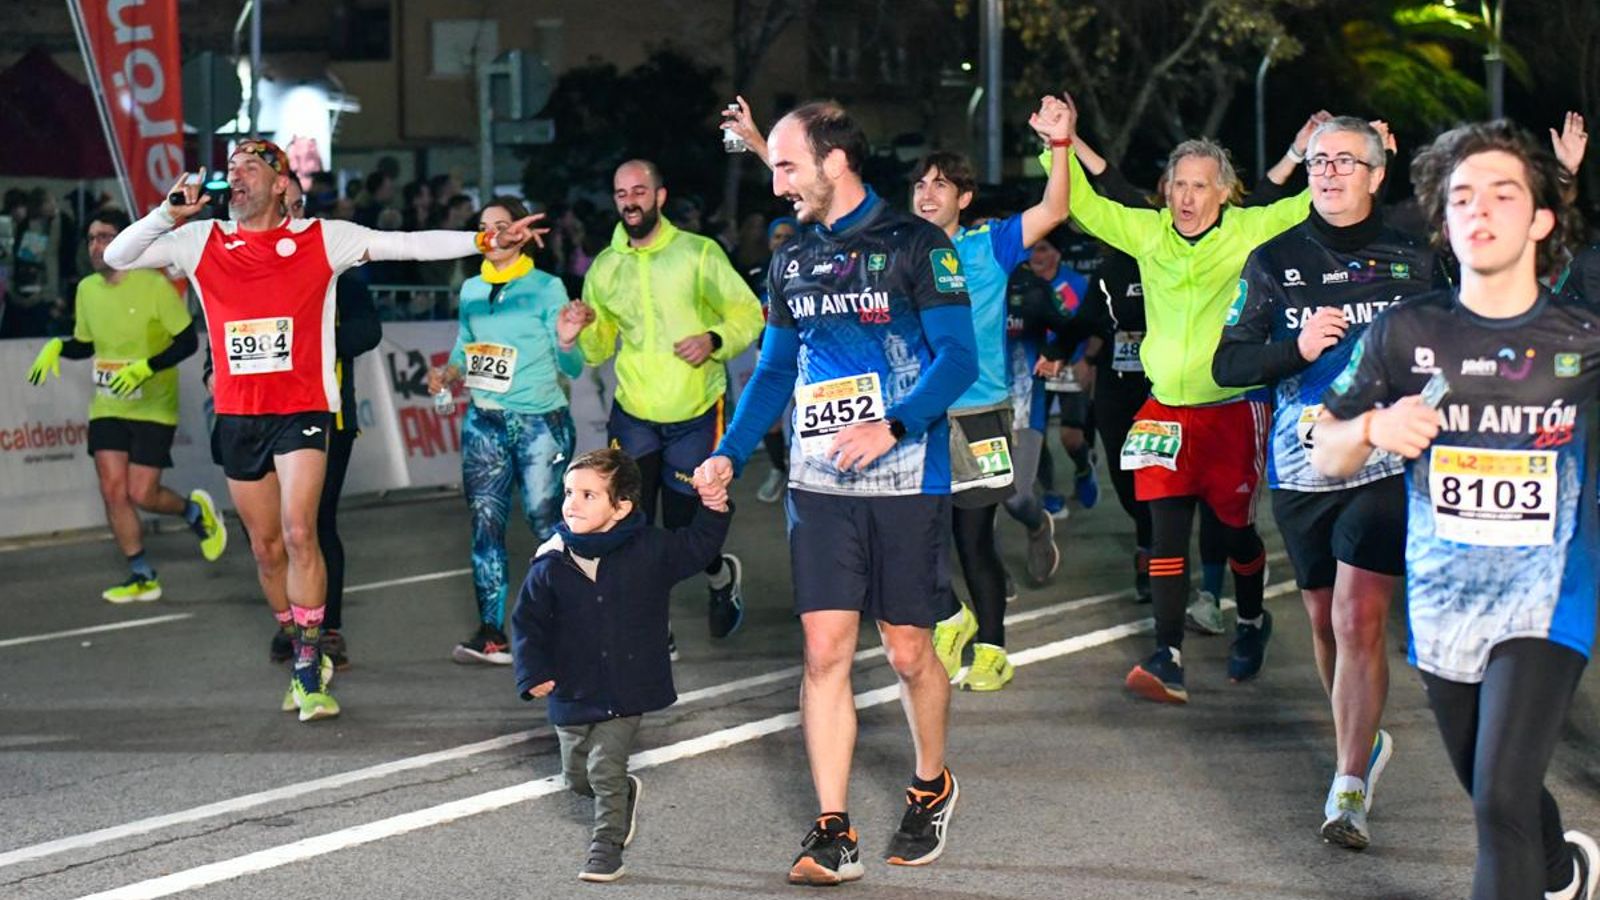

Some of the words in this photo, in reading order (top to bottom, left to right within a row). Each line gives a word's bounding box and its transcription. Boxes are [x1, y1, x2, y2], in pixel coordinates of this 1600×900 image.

[1322, 269, 1349, 285] jaén
[787, 296, 815, 319] SAN
[821, 287, 889, 314] ANTÓN
[859, 307, 891, 324] 2025
[1285, 305, 1322, 329] SA
[232, 333, 287, 354] 5984
[804, 395, 876, 428] 5452
[1437, 404, 1470, 432] AN
[1478, 399, 1577, 434] ANTÓN
[1457, 455, 1478, 470] 42
[1442, 476, 1542, 510] 8103
